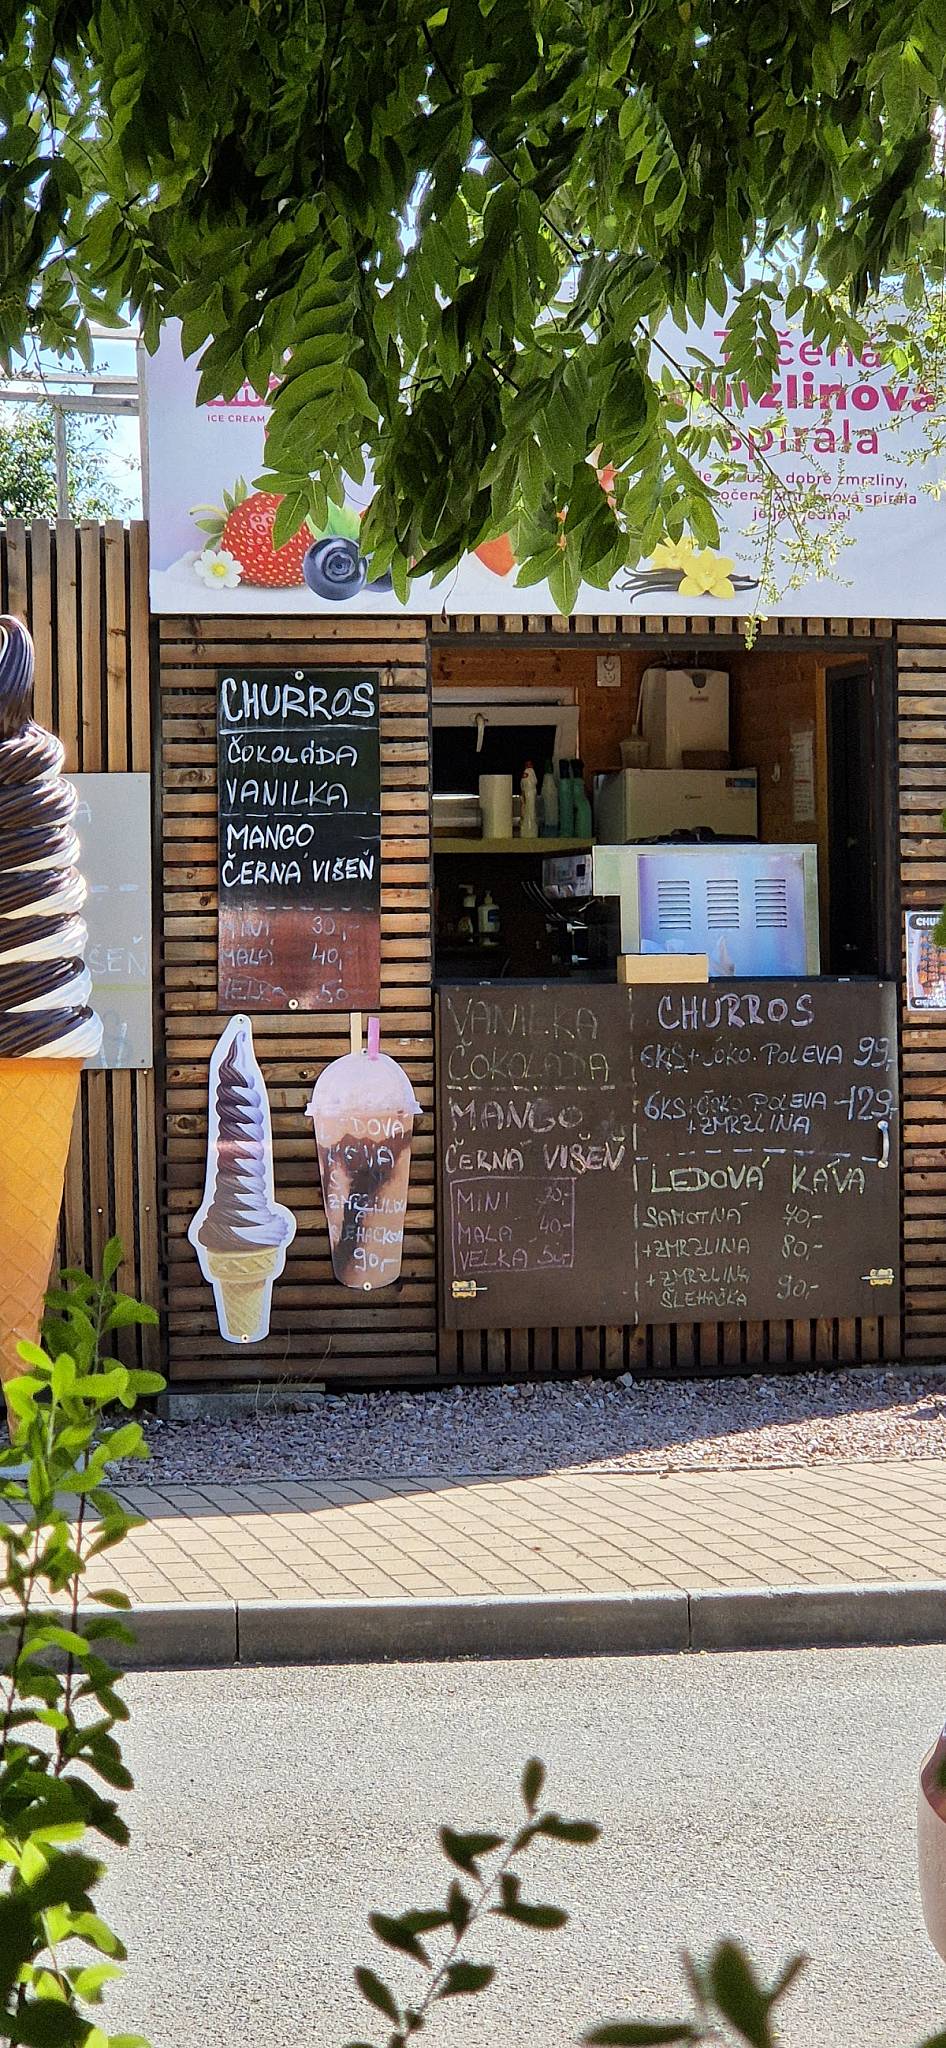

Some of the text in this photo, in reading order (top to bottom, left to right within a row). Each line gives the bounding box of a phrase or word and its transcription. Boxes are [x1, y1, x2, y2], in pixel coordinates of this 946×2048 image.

[207, 414, 265, 423] ICE CREAM
[221, 677, 375, 722] CHURROS
[227, 734, 358, 767] ČOKOLÁDA
[225, 778, 348, 809] VANILKA
[226, 823, 314, 851] MANGO
[221, 849, 375, 888] ČERNÁ VIŠEŇ
[657, 993, 815, 1030] CHURROS
[448, 1097, 584, 1133] MANGO
[650, 1156, 867, 1195] LEDOVÁ KÁVA
[457, 1188, 510, 1214] MINI
